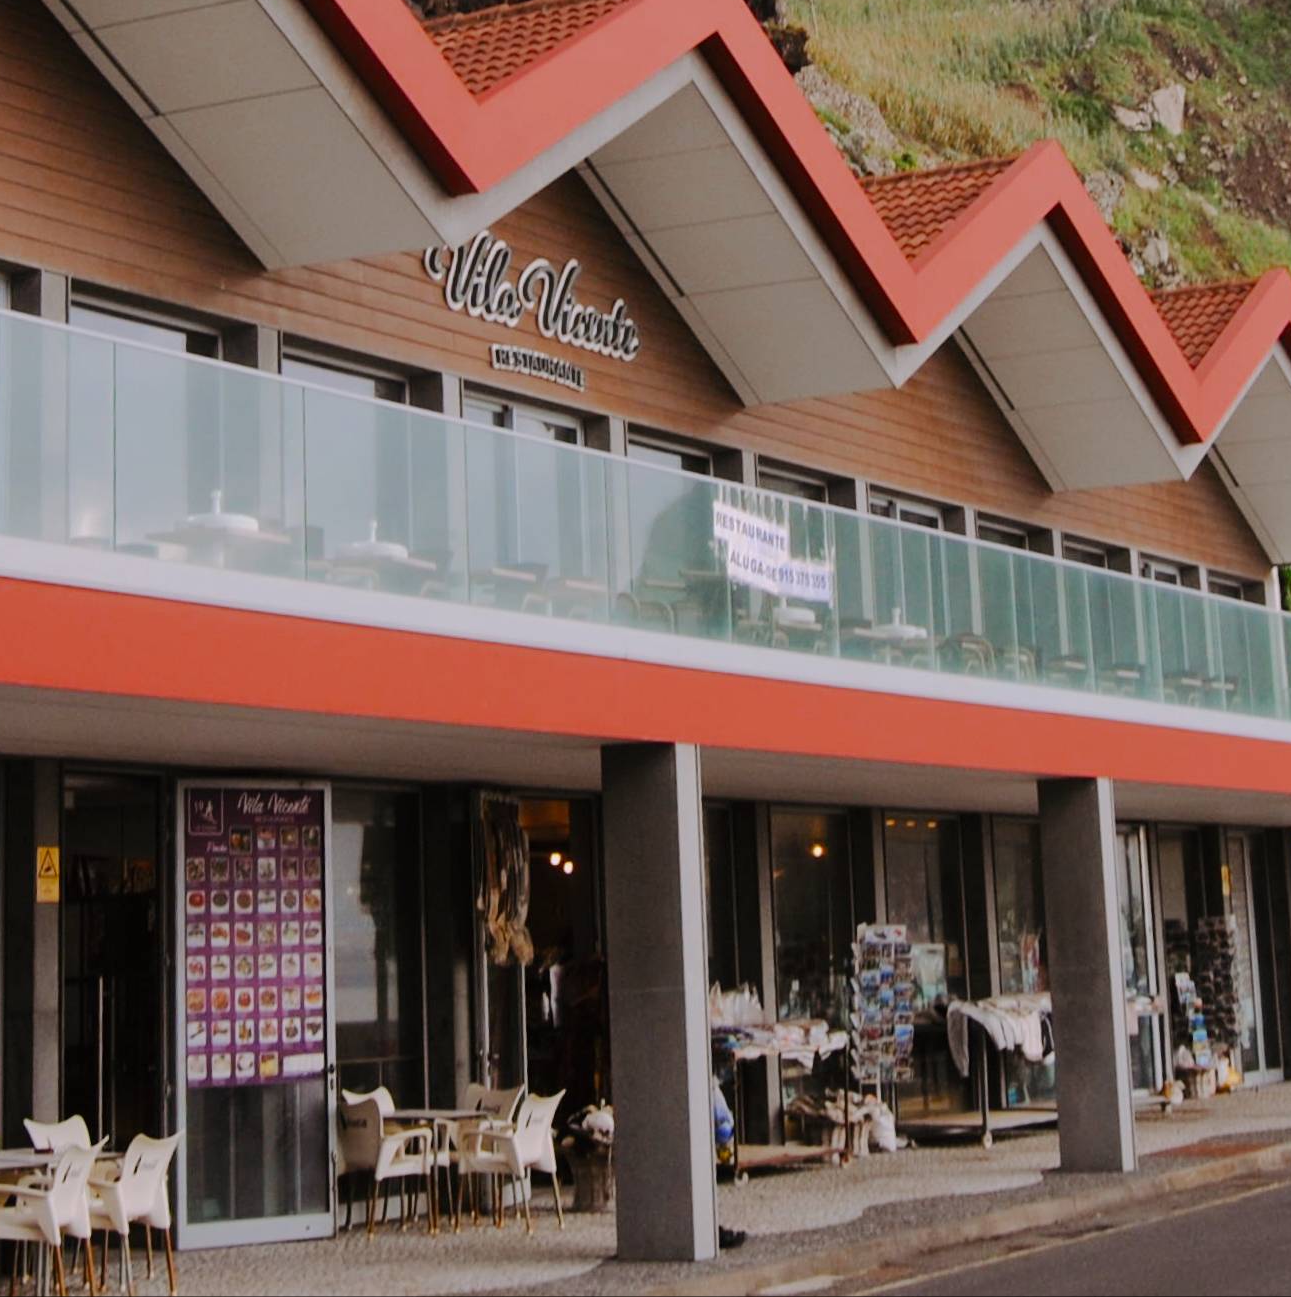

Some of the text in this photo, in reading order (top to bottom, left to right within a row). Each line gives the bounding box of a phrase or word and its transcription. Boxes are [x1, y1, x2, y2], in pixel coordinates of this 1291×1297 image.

[424, 230, 642, 362] Vila Vicente
[490, 343, 586, 393] RESTAURANTE
[715, 511, 786, 551] RESTAURANTE
